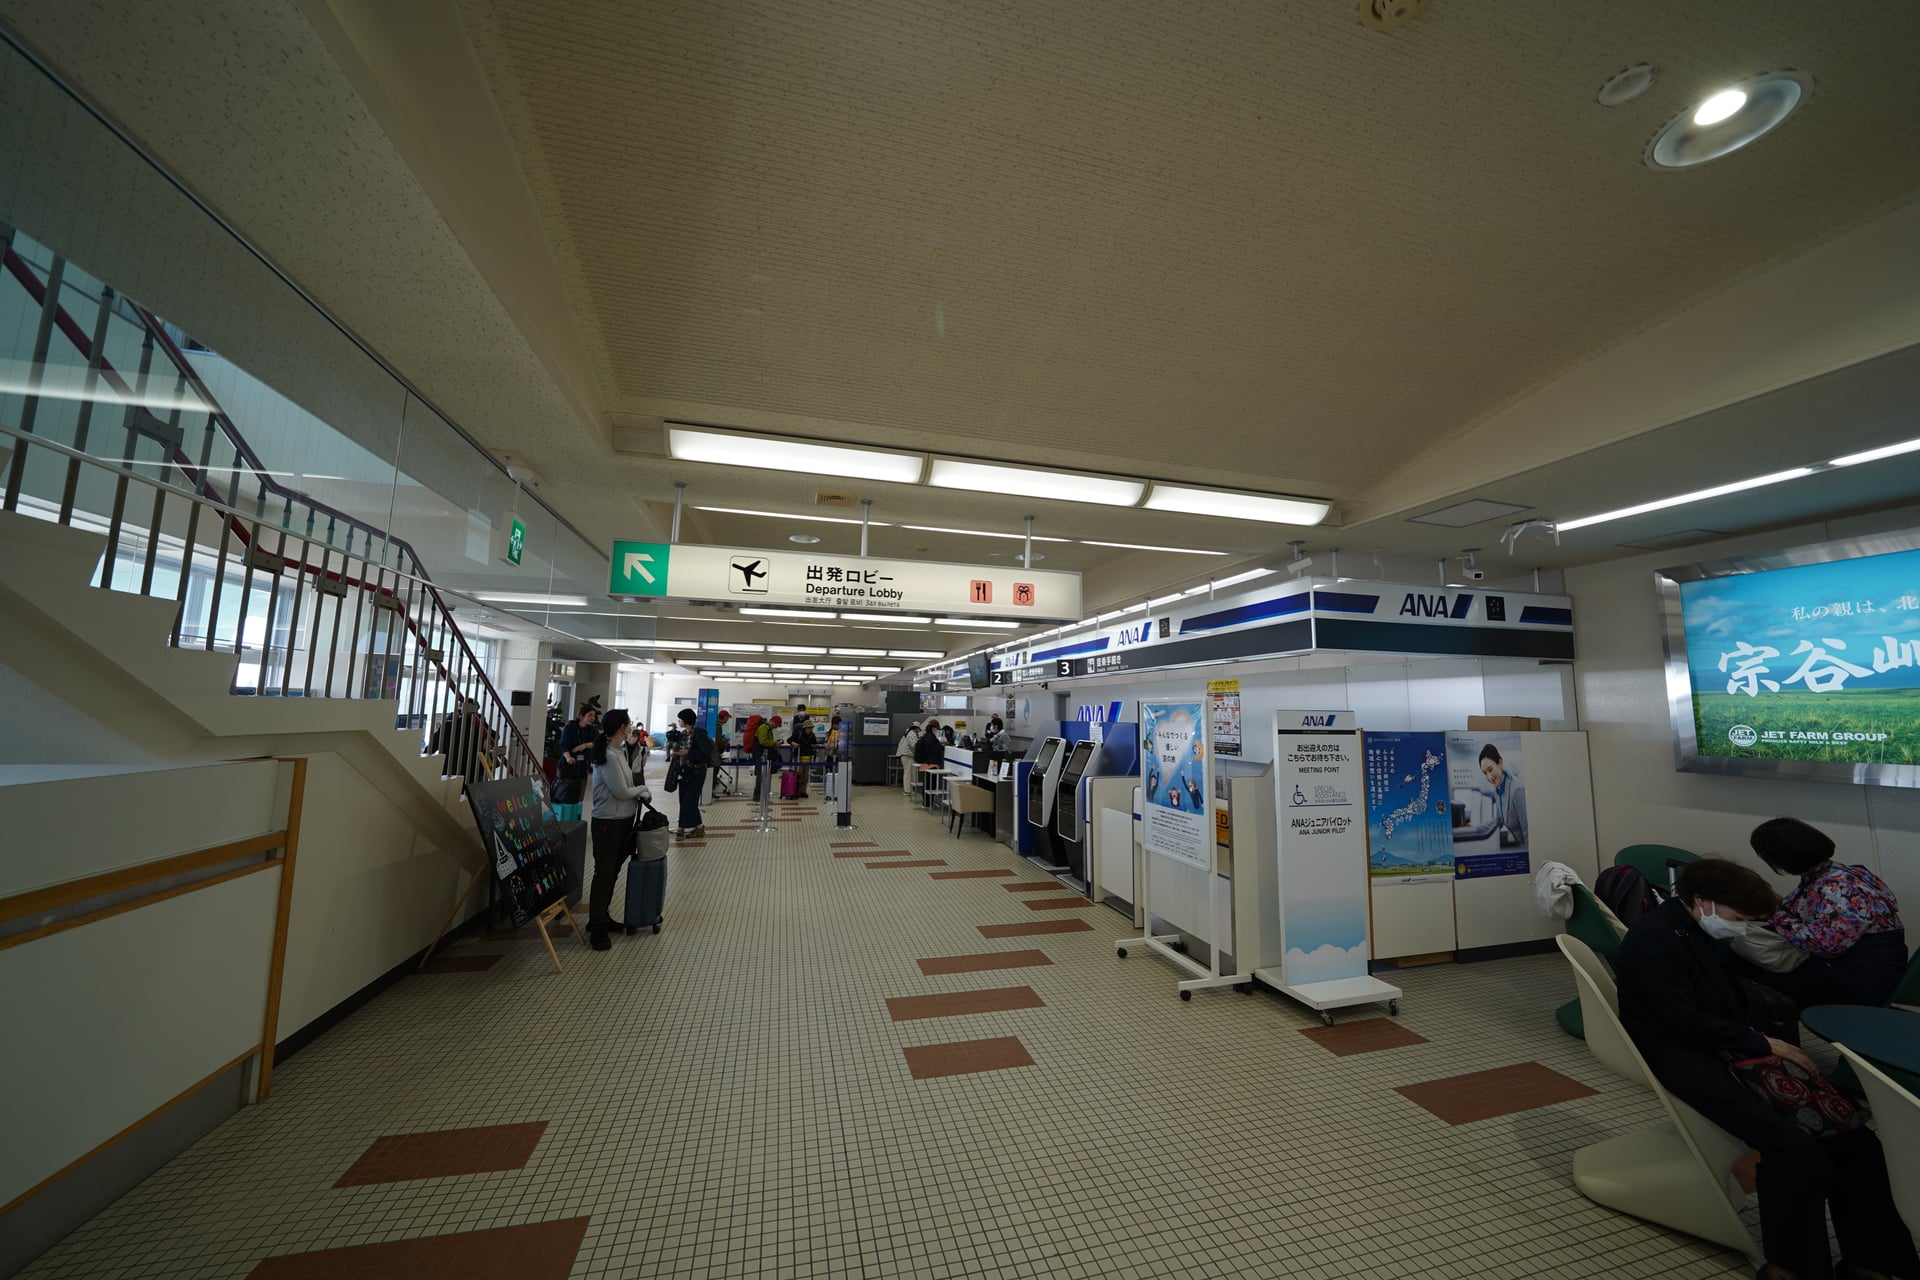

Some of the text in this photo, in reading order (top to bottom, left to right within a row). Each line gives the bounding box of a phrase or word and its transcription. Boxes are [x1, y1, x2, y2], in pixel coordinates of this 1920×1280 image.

[806, 565, 894, 584] 出発ロビー
[806, 583, 903, 600] Departure Lobby
[1399, 592, 1449, 618] ANA
[1117, 626, 1140, 647] ANA
[1061, 662, 1070, 675] 3
[994, 673, 1002, 683] 2
[932, 683, 937, 691] 1
[1076, 705, 1106, 722] ANA
[1302, 715, 1325, 727] ANA
[1761, 731, 1888, 742] JET FARM GROUP
[1297, 744, 1340, 752] お出迎えの方は
[1288, 753, 1350, 762] こちらでお待ち下さい。
